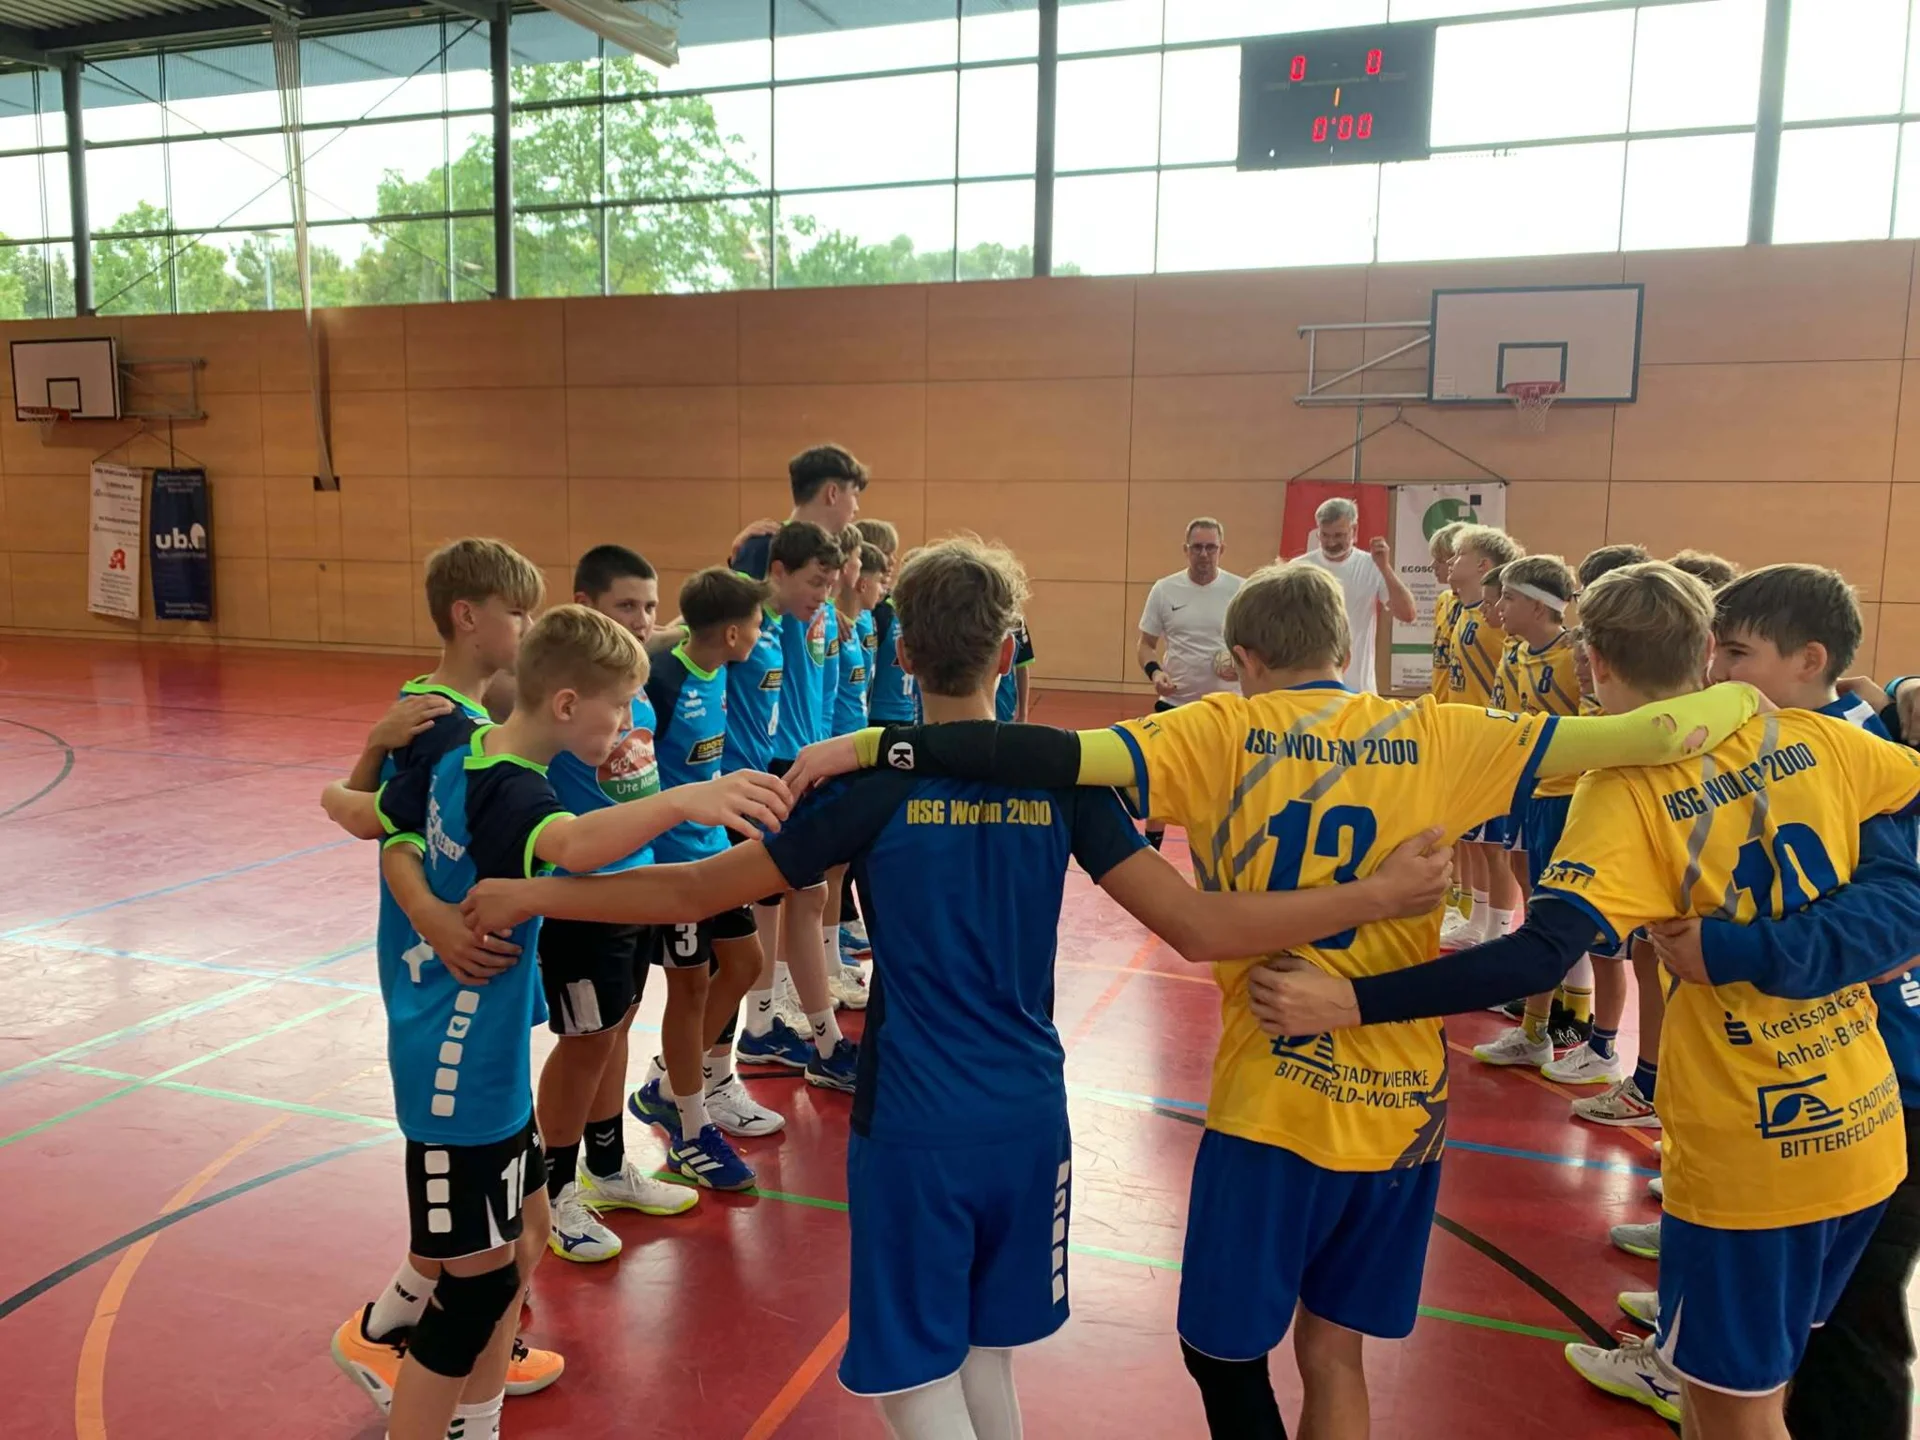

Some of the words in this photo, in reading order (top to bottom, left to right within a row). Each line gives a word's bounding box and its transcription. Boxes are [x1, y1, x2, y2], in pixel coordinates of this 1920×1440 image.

[1290, 55, 1306, 81] 0
[1365, 48, 1382, 75] 0
[1537, 665, 1553, 694] 8
[1363, 738, 1418, 766] 2000
[1662, 787, 1708, 822] HSG
[1761, 742, 1818, 782] 2000
[907, 799, 945, 825] HSG
[1006, 798, 1052, 826] 2000
[1264, 799, 1378, 951] 13
[1732, 822, 1840, 921] 10
[674, 923, 698, 957] 3
[1331, 1063, 1429, 1088] STADTWERKE
